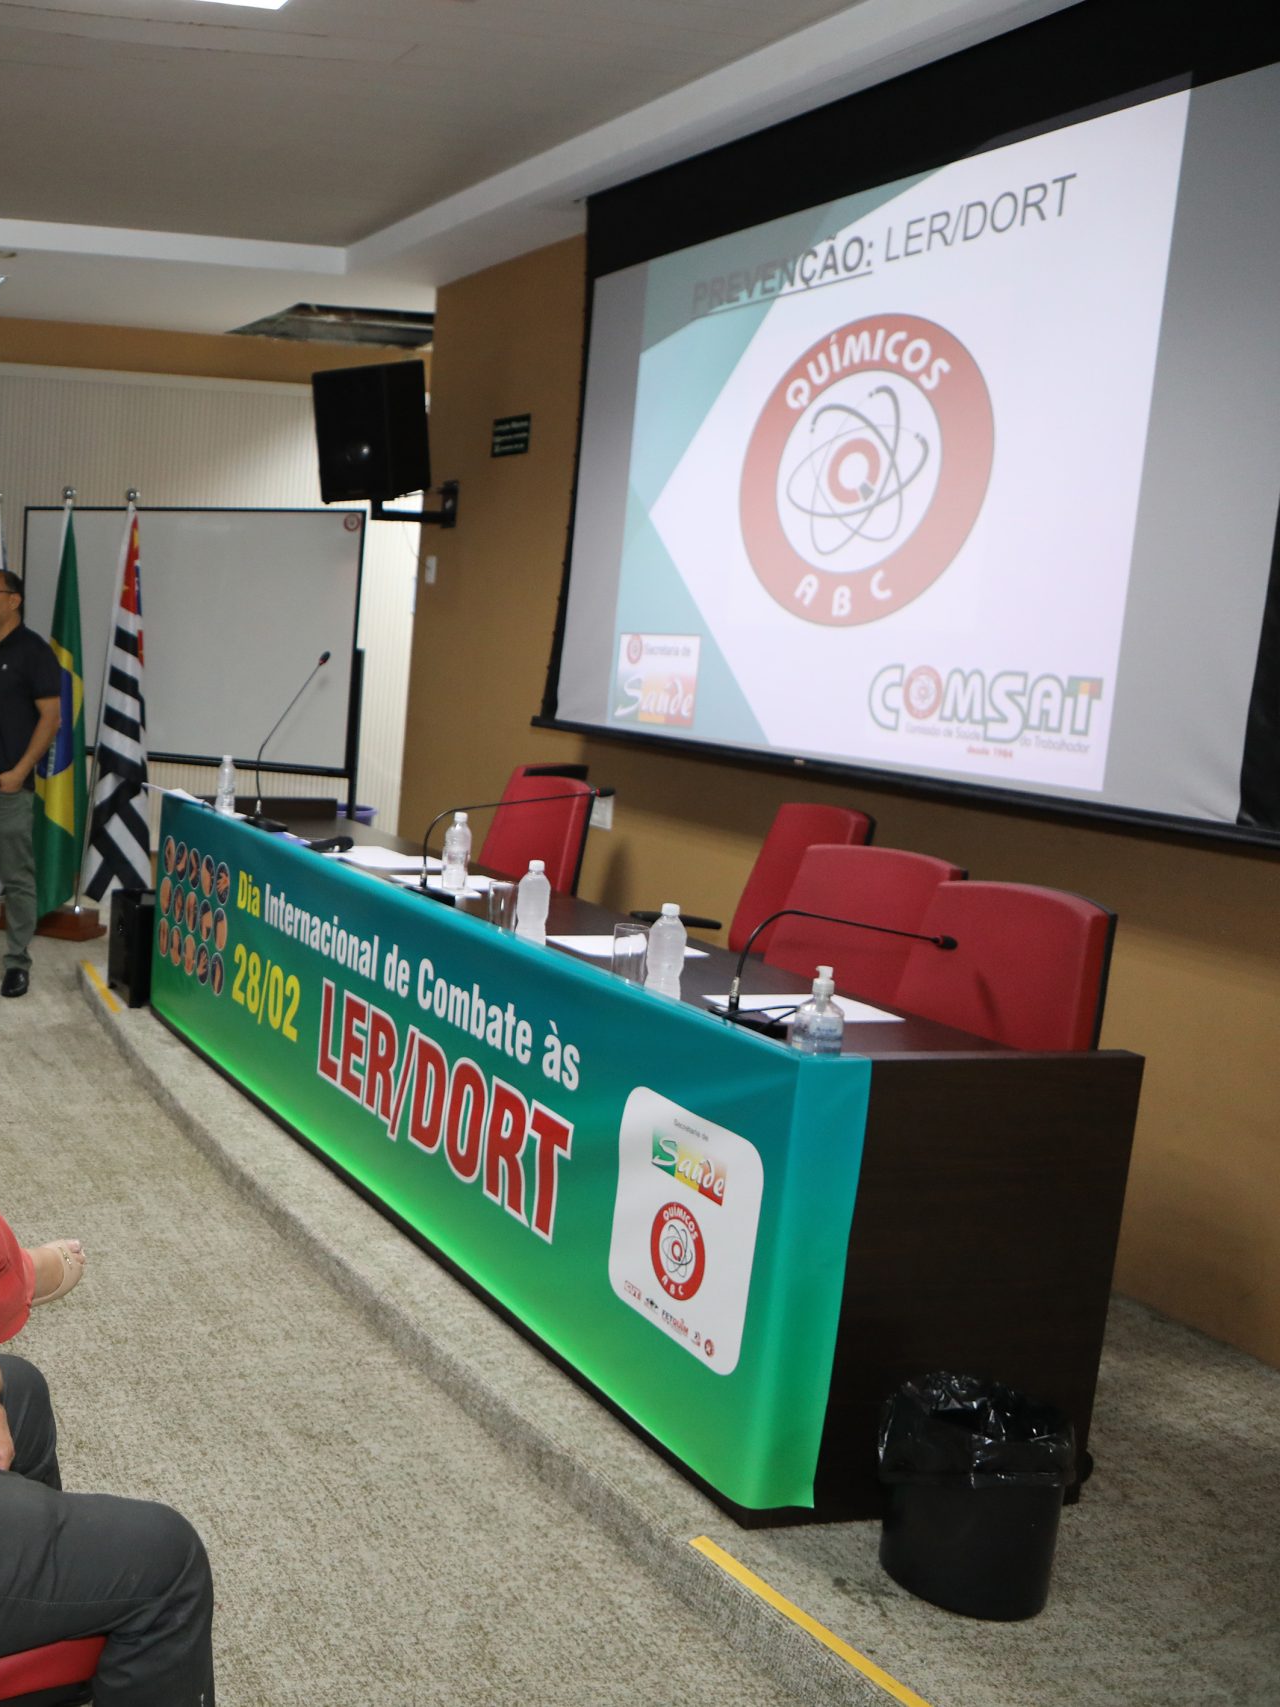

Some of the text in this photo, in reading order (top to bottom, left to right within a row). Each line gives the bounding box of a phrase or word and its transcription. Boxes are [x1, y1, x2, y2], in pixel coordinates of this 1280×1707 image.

[688, 172, 1078, 319] PREVENÇÃO: LER/DORT
[785, 328, 951, 410] QUÍMICOS
[868, 663, 1104, 744] COMSAT
[231, 943, 301, 1043] 28/02
[237, 870, 581, 1092] Dia Internacional de Combate às
[317, 976, 575, 1245] LER/DORT
[662, 1203, 699, 1240] QUÍMICOS
